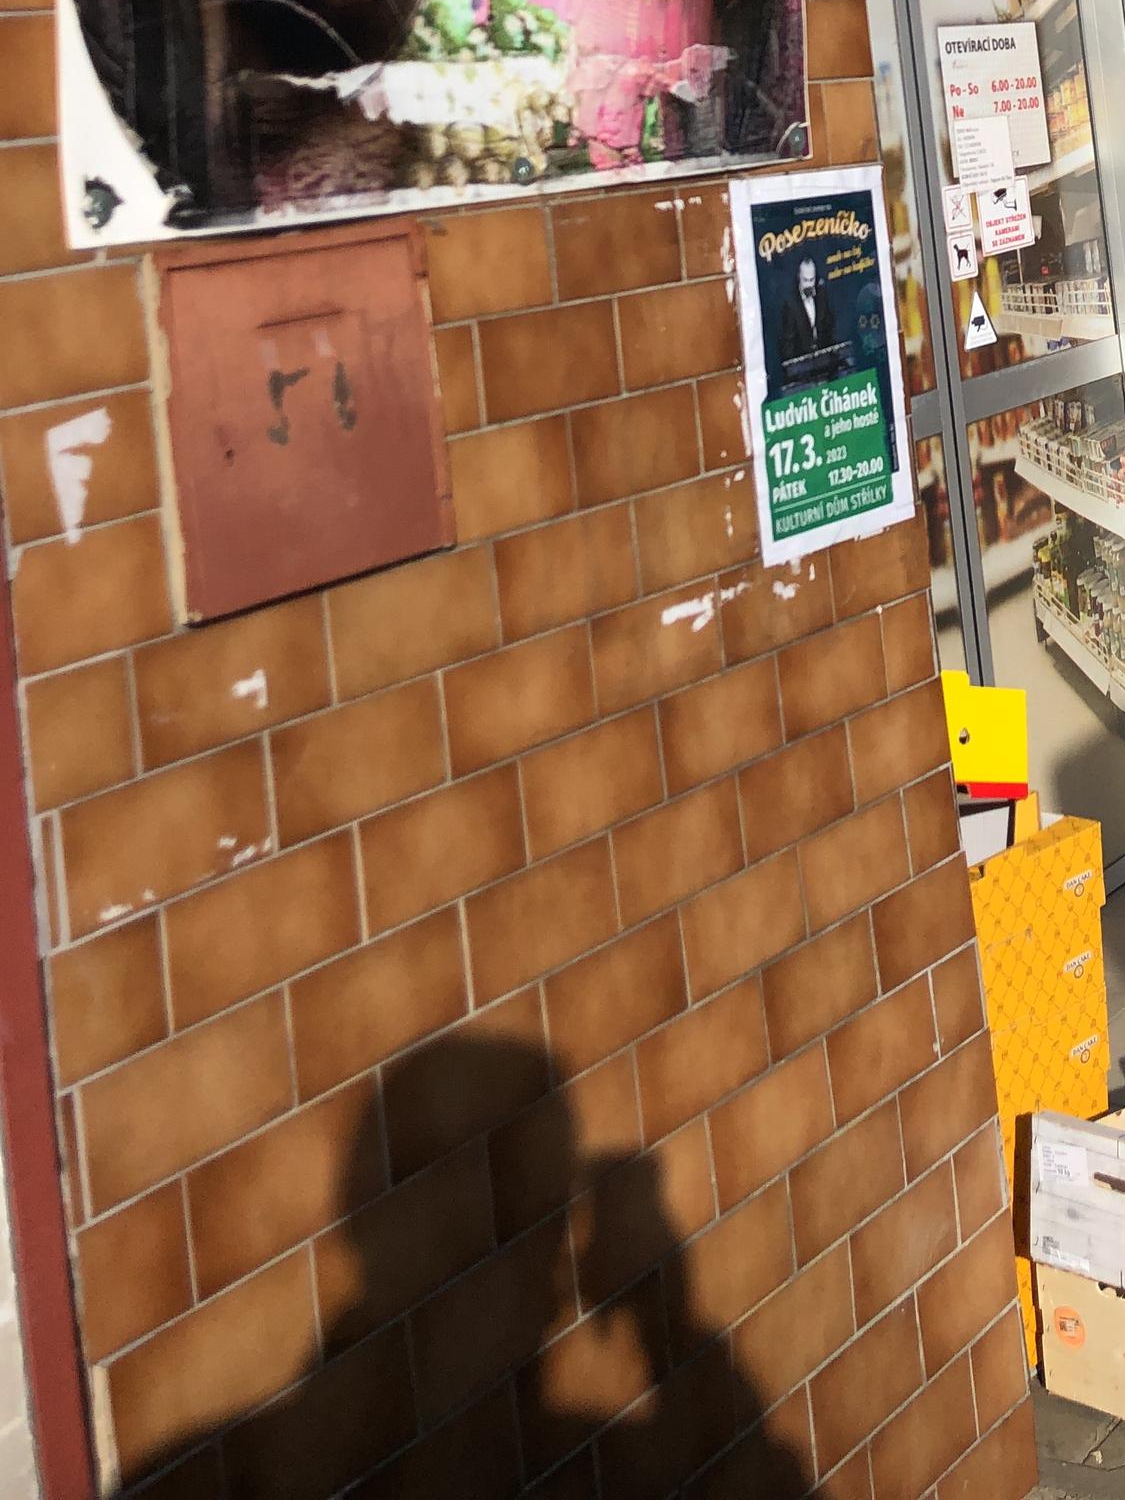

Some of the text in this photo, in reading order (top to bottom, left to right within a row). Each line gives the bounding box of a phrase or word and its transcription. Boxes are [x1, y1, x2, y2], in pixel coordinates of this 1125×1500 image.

[945, 37, 1017, 54] OTEVÍRACÍ DOBA
[950, 83, 961, 97] Po
[967, 82, 979, 96] So
[991, 79, 1010, 93] 6.00
[1015, 76, 1037, 91] 20.00
[952, 104, 965, 118] Ne
[993, 99, 1012, 113] 7.00
[1017, 97, 1040, 111] 20.00
[765, 382, 878, 433] Ludvík Čihánek
[825, 445, 848, 464] 2023
[772, 478, 808, 504] PÁTEK
[774, 484, 888, 534] KULTURNÍ DŮM STŘÍLKY
